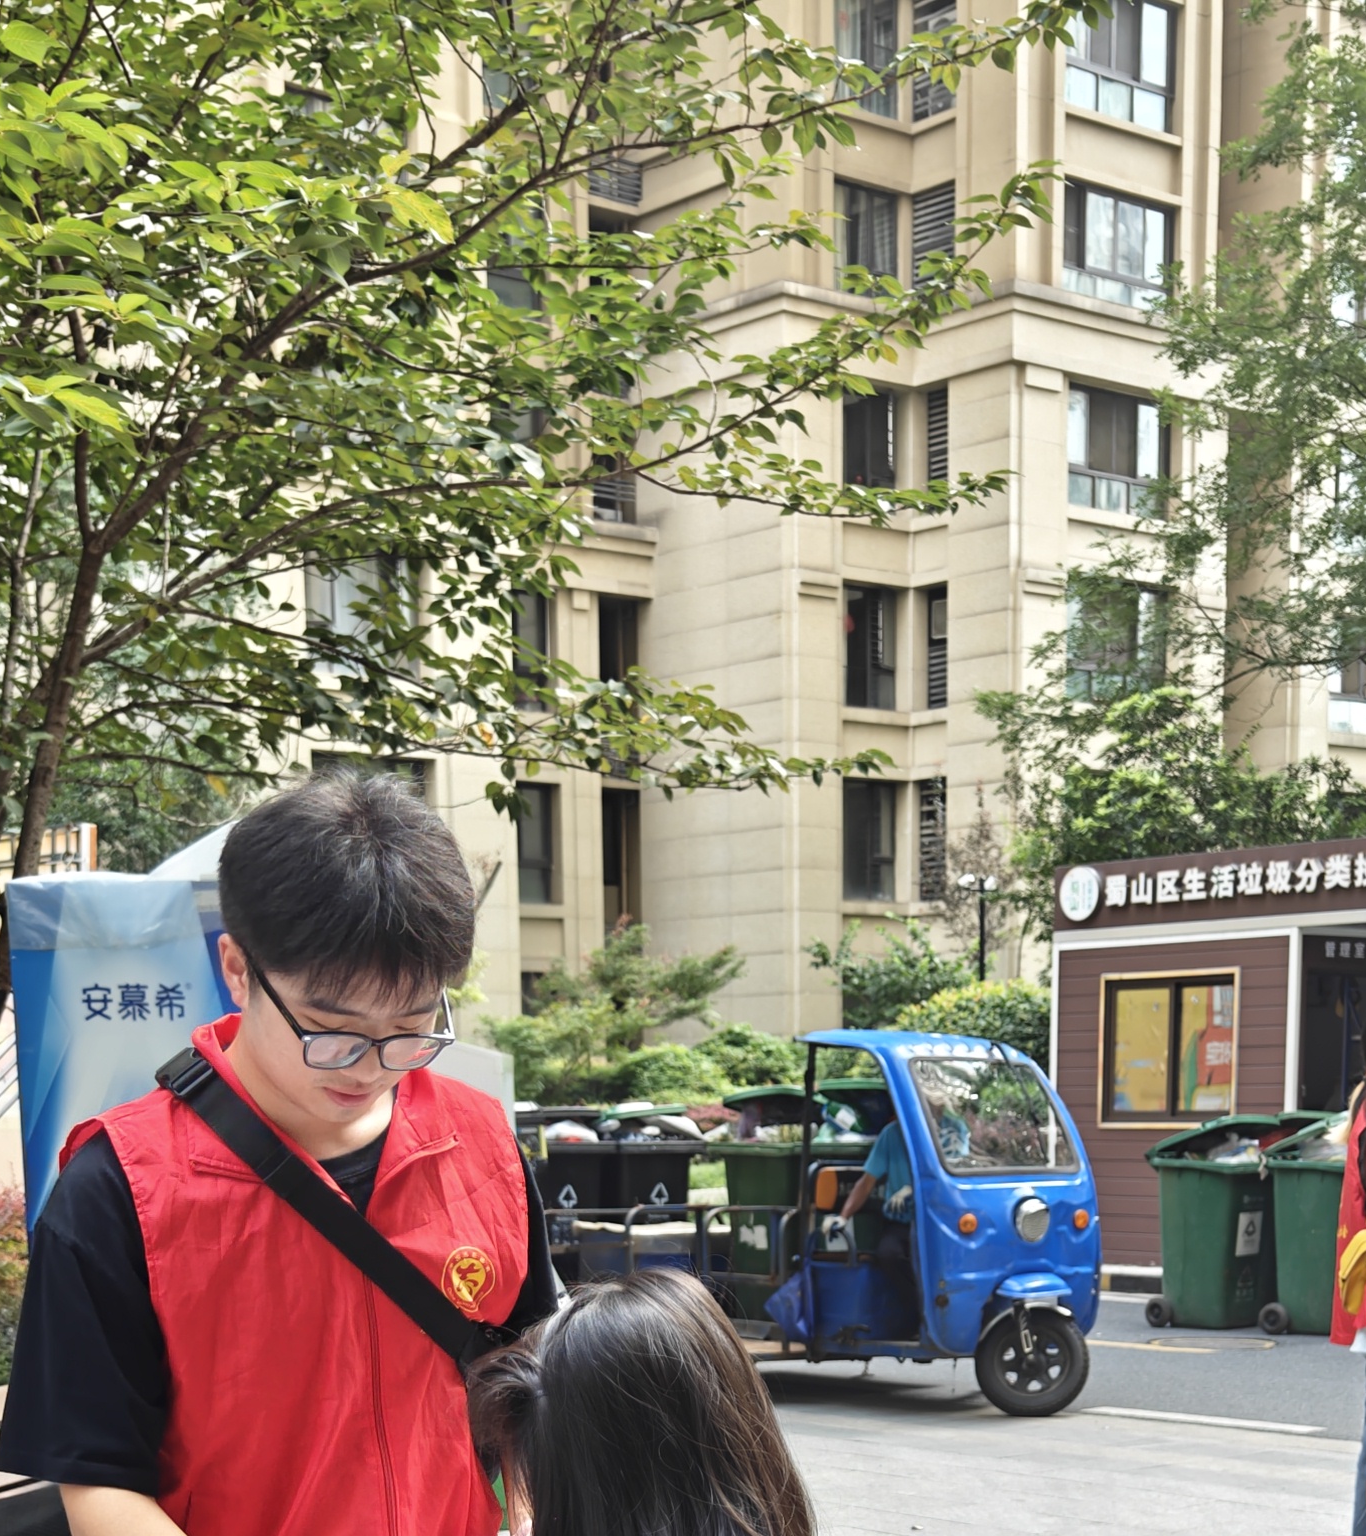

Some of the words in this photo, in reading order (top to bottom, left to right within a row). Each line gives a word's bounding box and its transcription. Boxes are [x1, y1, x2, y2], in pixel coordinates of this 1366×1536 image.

[1325, 940, 1366, 959] 管理室
[82, 983, 186, 1021] 安慕希
